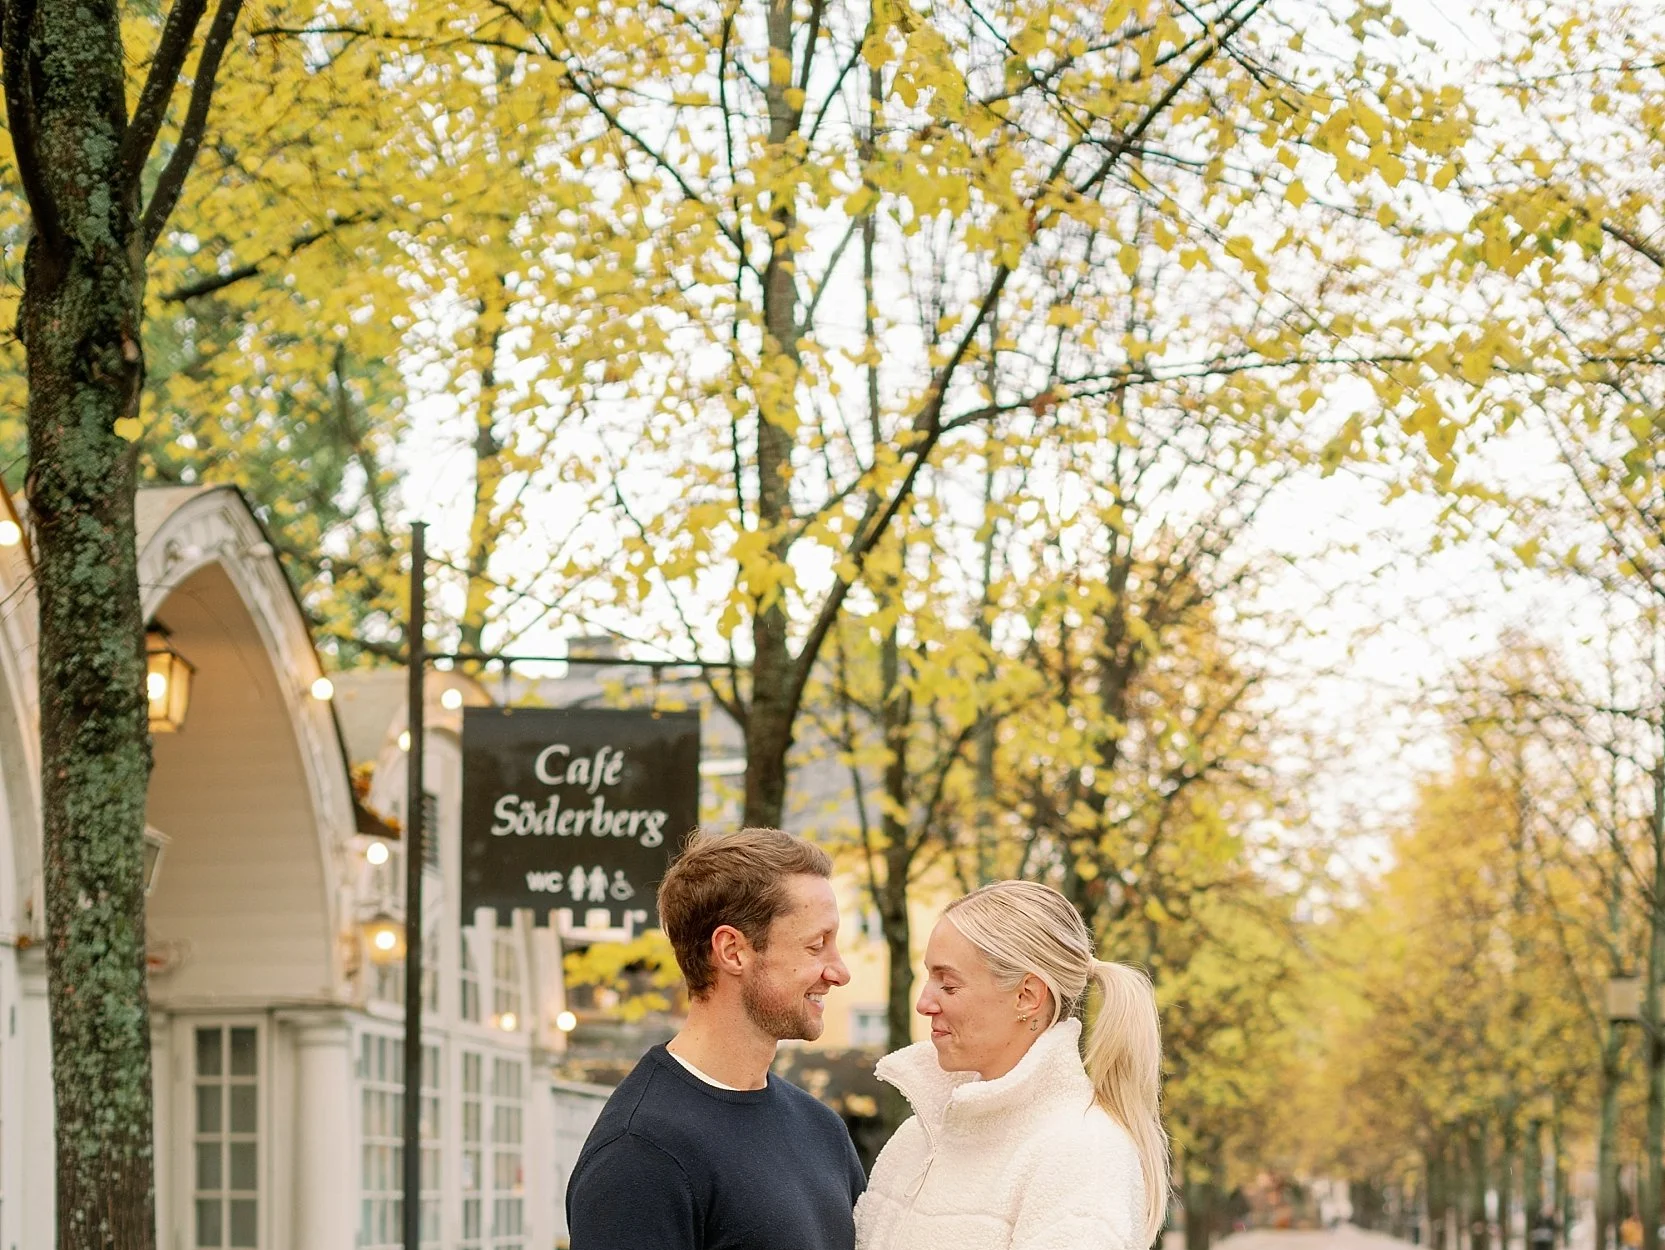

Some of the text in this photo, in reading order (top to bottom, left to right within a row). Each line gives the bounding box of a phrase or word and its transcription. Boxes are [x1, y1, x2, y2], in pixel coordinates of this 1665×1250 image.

[535, 744, 624, 794] Café
[491, 795, 668, 848] Söderberg
[526, 870, 563, 893] WC
